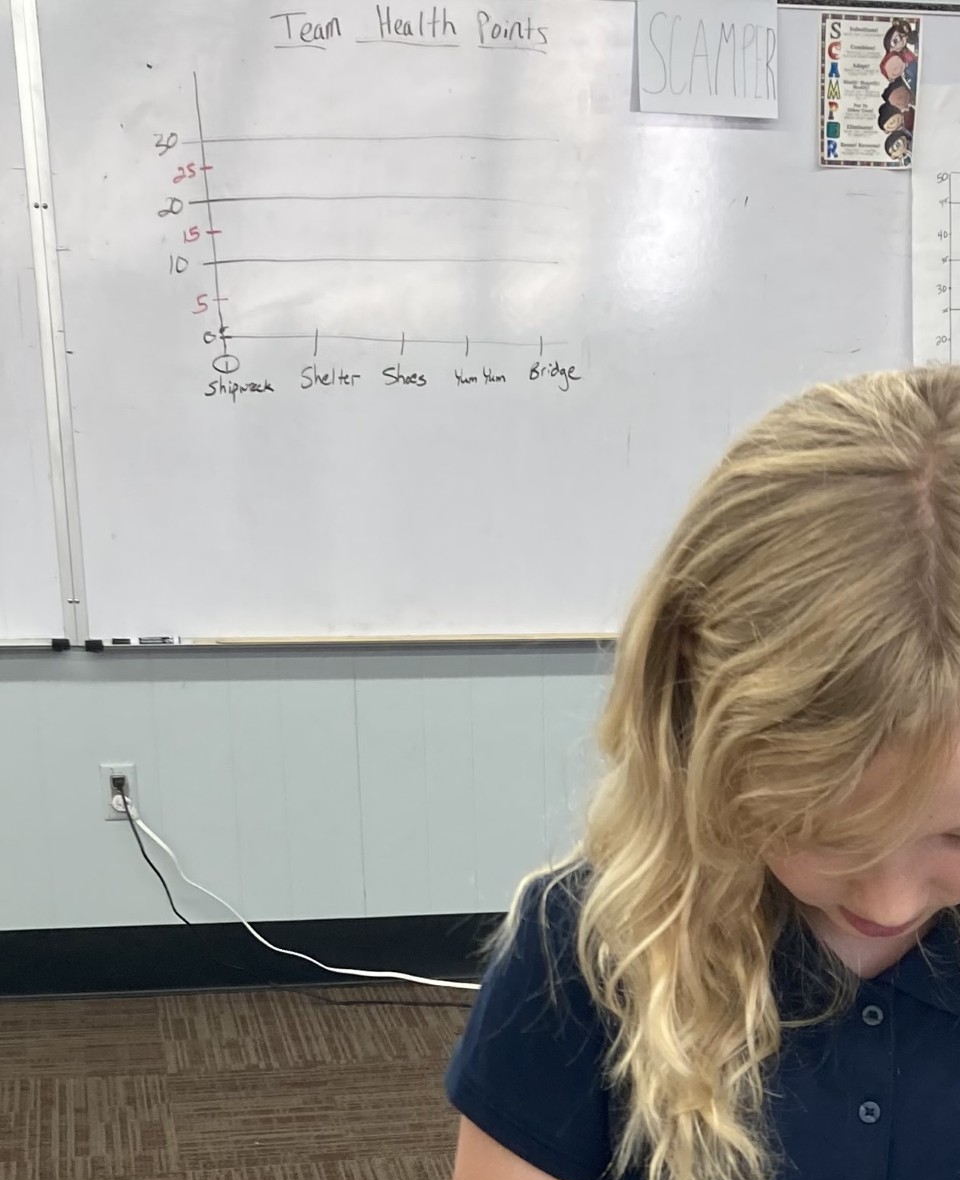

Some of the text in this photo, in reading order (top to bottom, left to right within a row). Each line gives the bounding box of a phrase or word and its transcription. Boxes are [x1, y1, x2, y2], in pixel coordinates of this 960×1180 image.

[270, 4, 548, 45] Team Health Points
[642, 11, 776, 100] SCAMPER
[154, 132, 178, 156] 30
[173, 163, 196, 183] 25
[936, 173, 949, 183] 50
[157, 197, 184, 217] 20
[184, 226, 200, 243] 15
[937, 231, 948, 240] 40
[169, 255, 188, 275] 10
[936, 284, 948, 295] 30
[192, 294, 208, 314] 5
[935, 336, 947, 346] 20
[301, 364, 361, 389] Shelter
[382, 363, 427, 387] Shoes
[454, 369, 477, 386] Yum
[483, 367, 506, 385] Yum
[529, 360, 581, 391] Bridge
